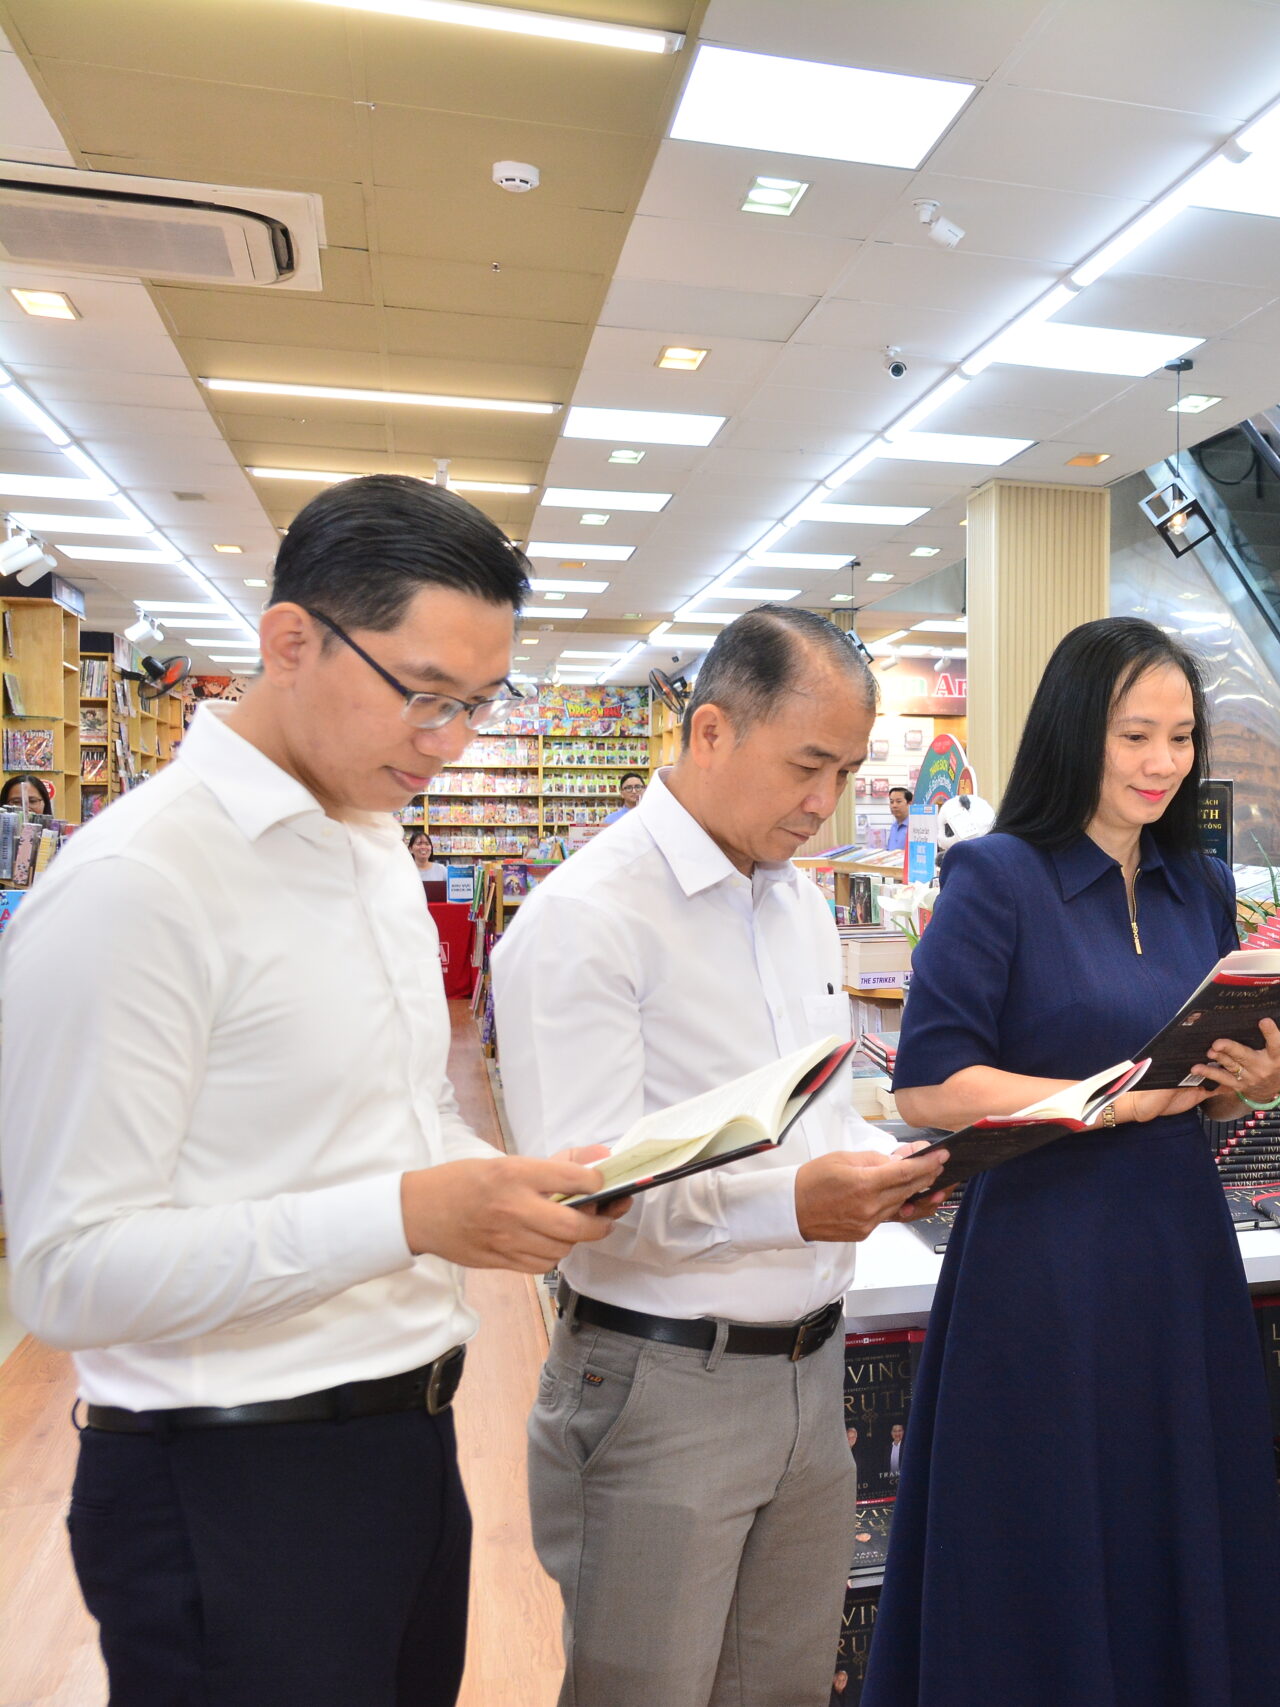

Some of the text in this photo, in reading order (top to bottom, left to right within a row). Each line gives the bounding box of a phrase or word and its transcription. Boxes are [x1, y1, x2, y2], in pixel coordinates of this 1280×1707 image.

[861, 976, 895, 985] THE STRIKER
[1254, 1154, 1280, 1162] LIVING
[1236, 1172, 1263, 1180] LIVING
